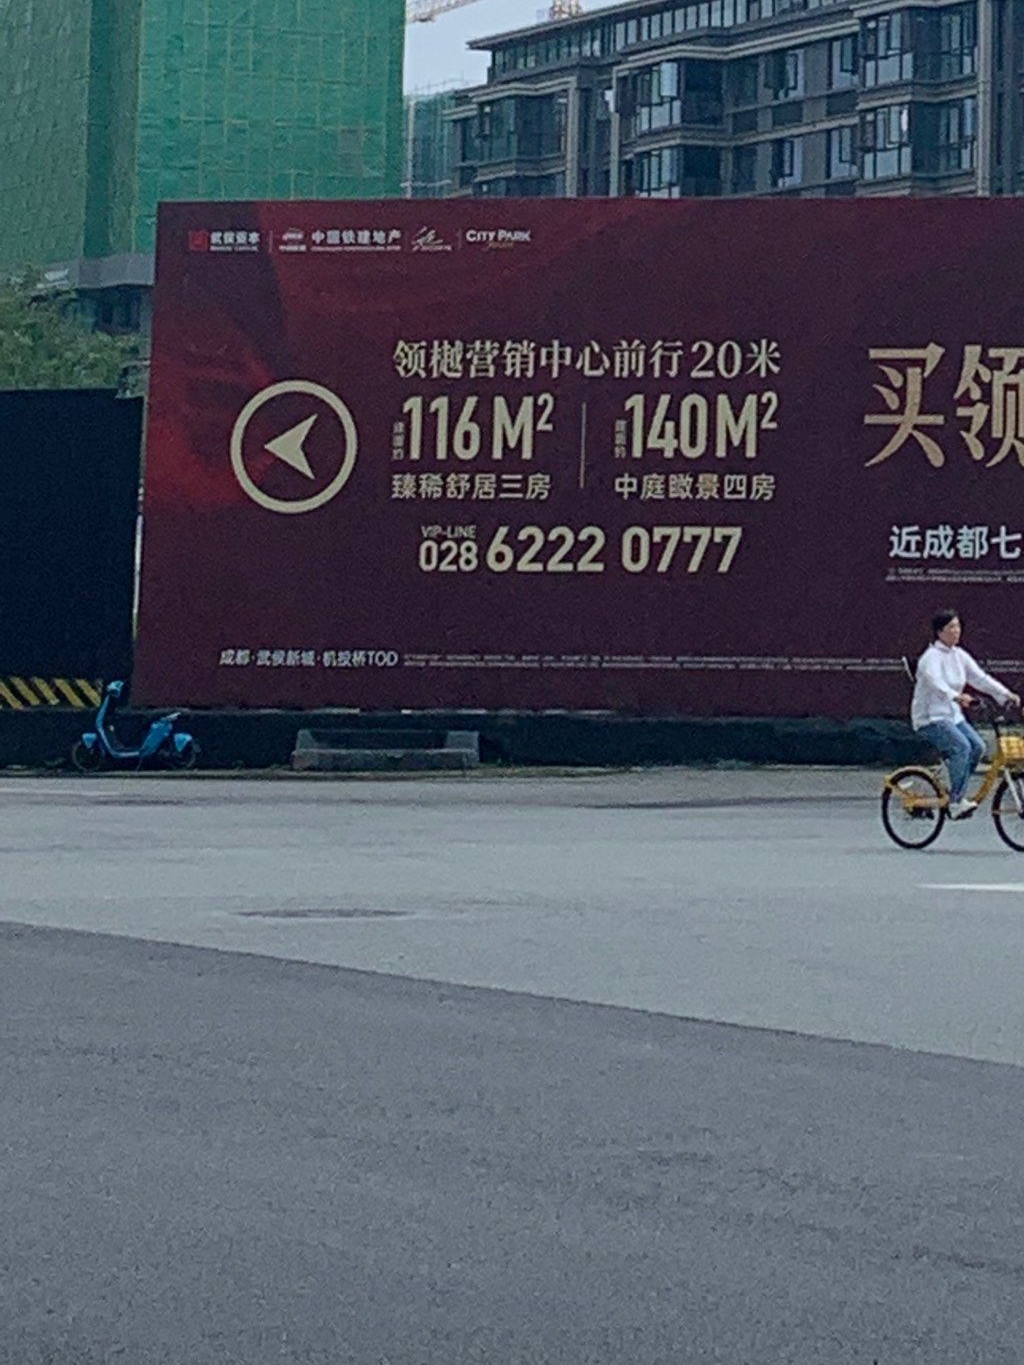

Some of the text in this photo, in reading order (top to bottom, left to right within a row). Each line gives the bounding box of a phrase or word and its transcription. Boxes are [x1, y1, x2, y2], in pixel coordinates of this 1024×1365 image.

[465, 229, 531, 242] CITY PARK
[392, 338, 781, 379] 领樾营销中心前行20米
[391, 472, 551, 500] 臻稀舒居三房
[614, 472, 776, 501] 中庭瞰景四房
[420, 525, 477, 539] VIP-LINE
[419, 525, 743, 573] 028 6222 0777
